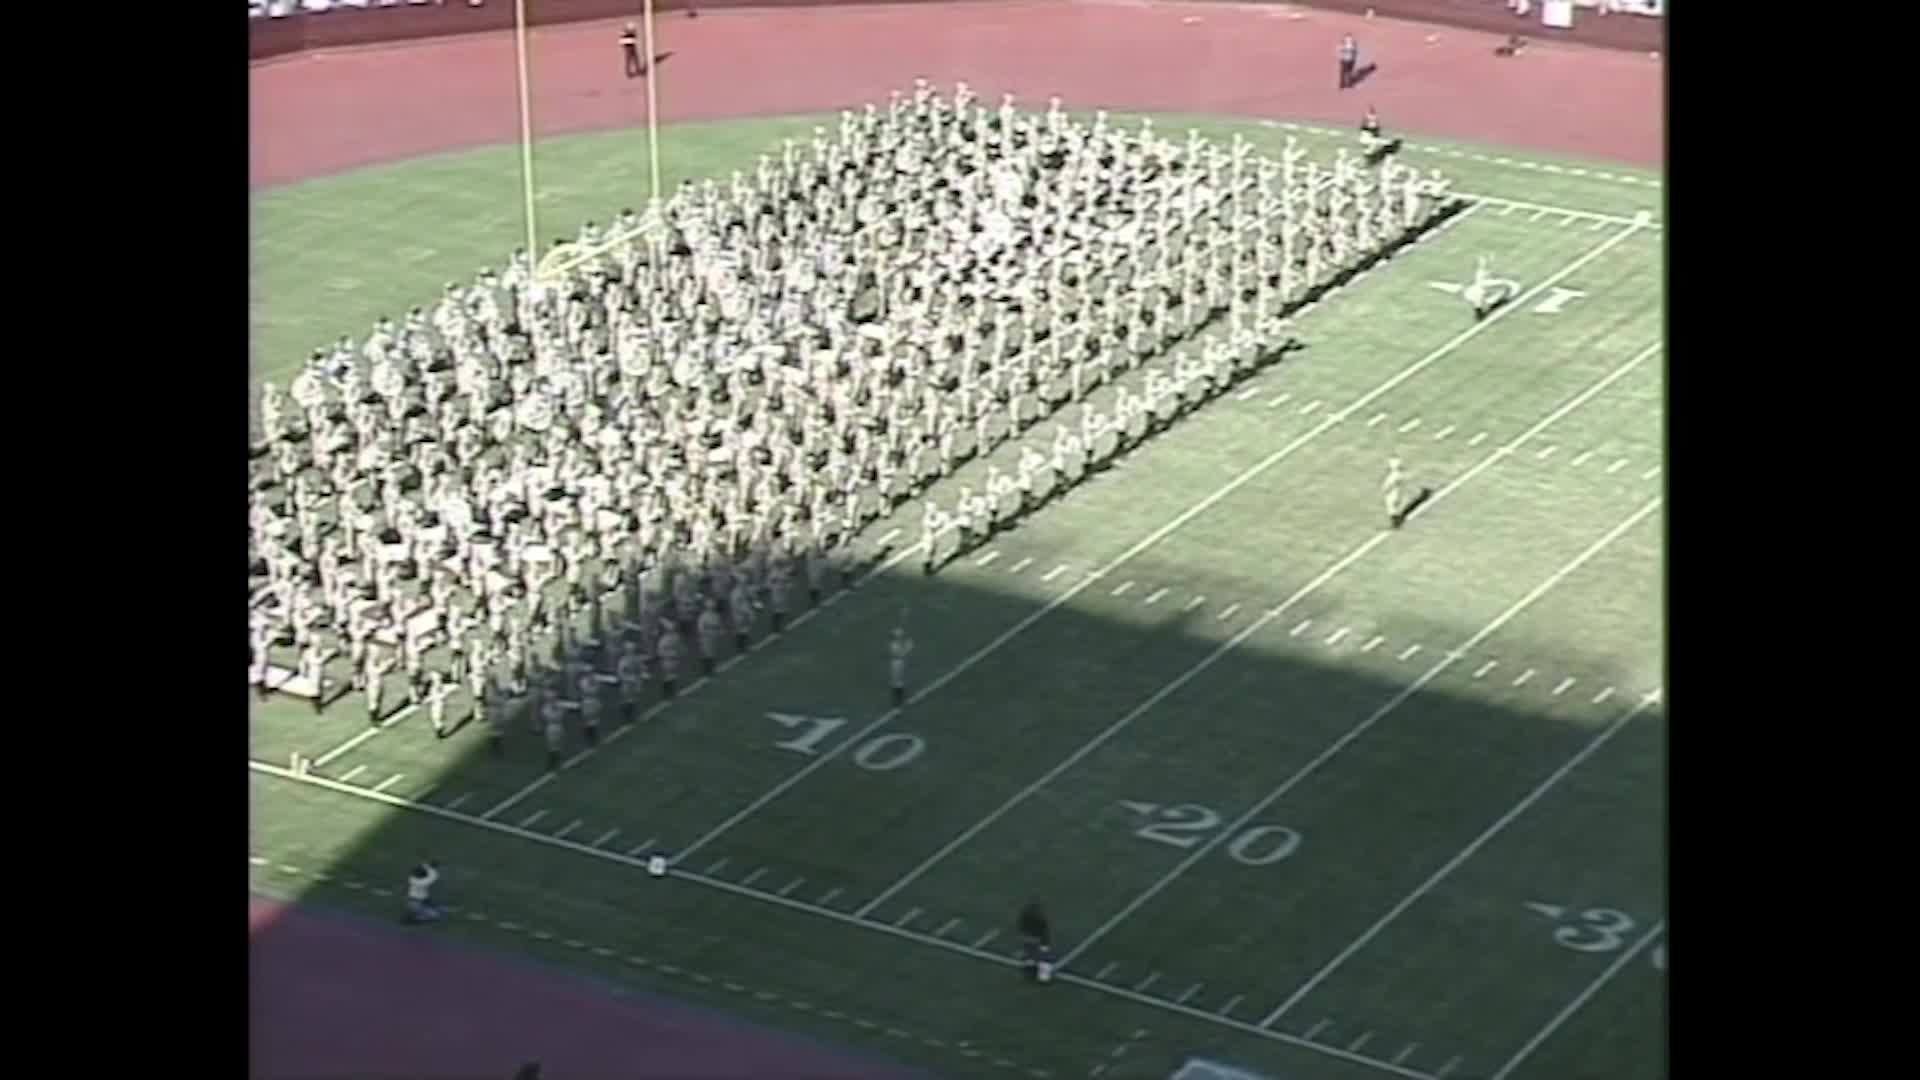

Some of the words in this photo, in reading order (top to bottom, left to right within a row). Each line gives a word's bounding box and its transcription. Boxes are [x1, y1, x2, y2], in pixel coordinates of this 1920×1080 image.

[772, 716, 926, 770] 10
[1135, 803, 1301, 864] 20
[1554, 908, 1665, 971] 3
